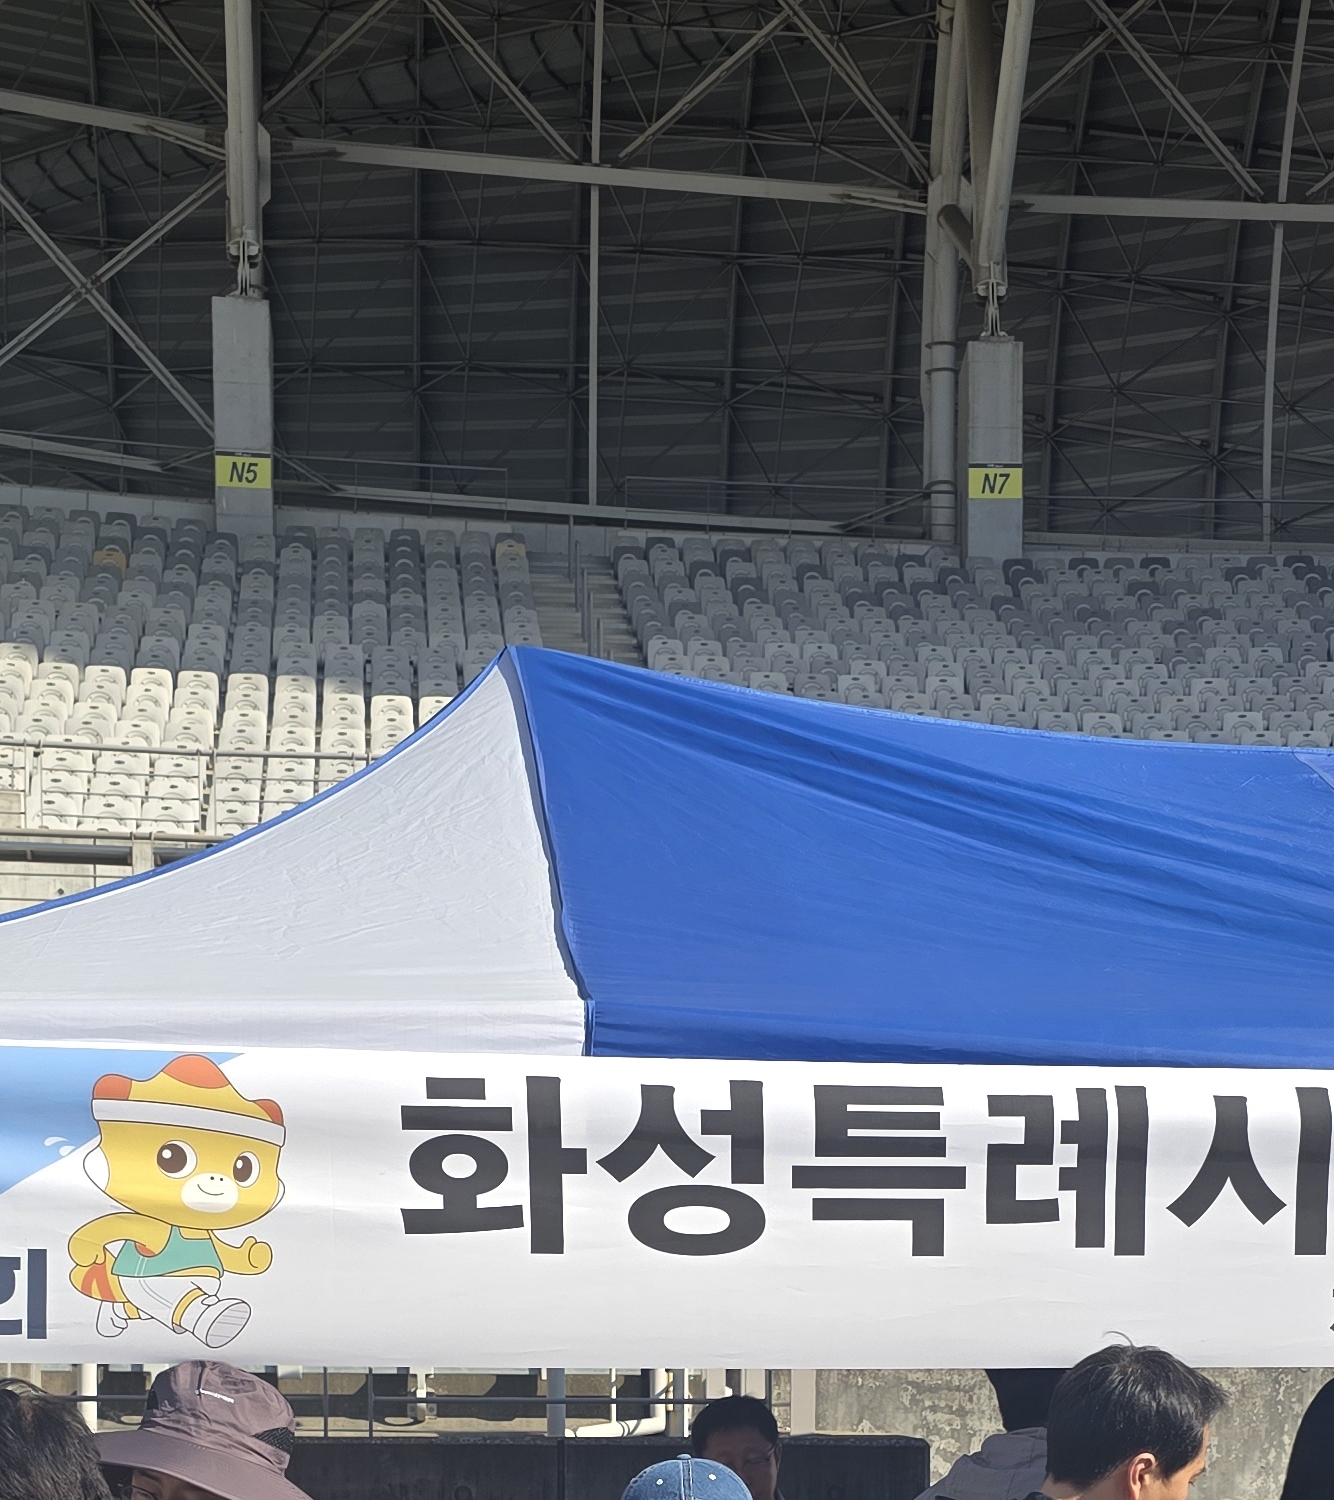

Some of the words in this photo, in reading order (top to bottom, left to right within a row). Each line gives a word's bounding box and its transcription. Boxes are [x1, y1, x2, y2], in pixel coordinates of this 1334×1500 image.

[228, 461, 259, 484] N5
[981, 472, 1011, 495] N7
[399, 1075, 1333, 1256] 화성특례시
